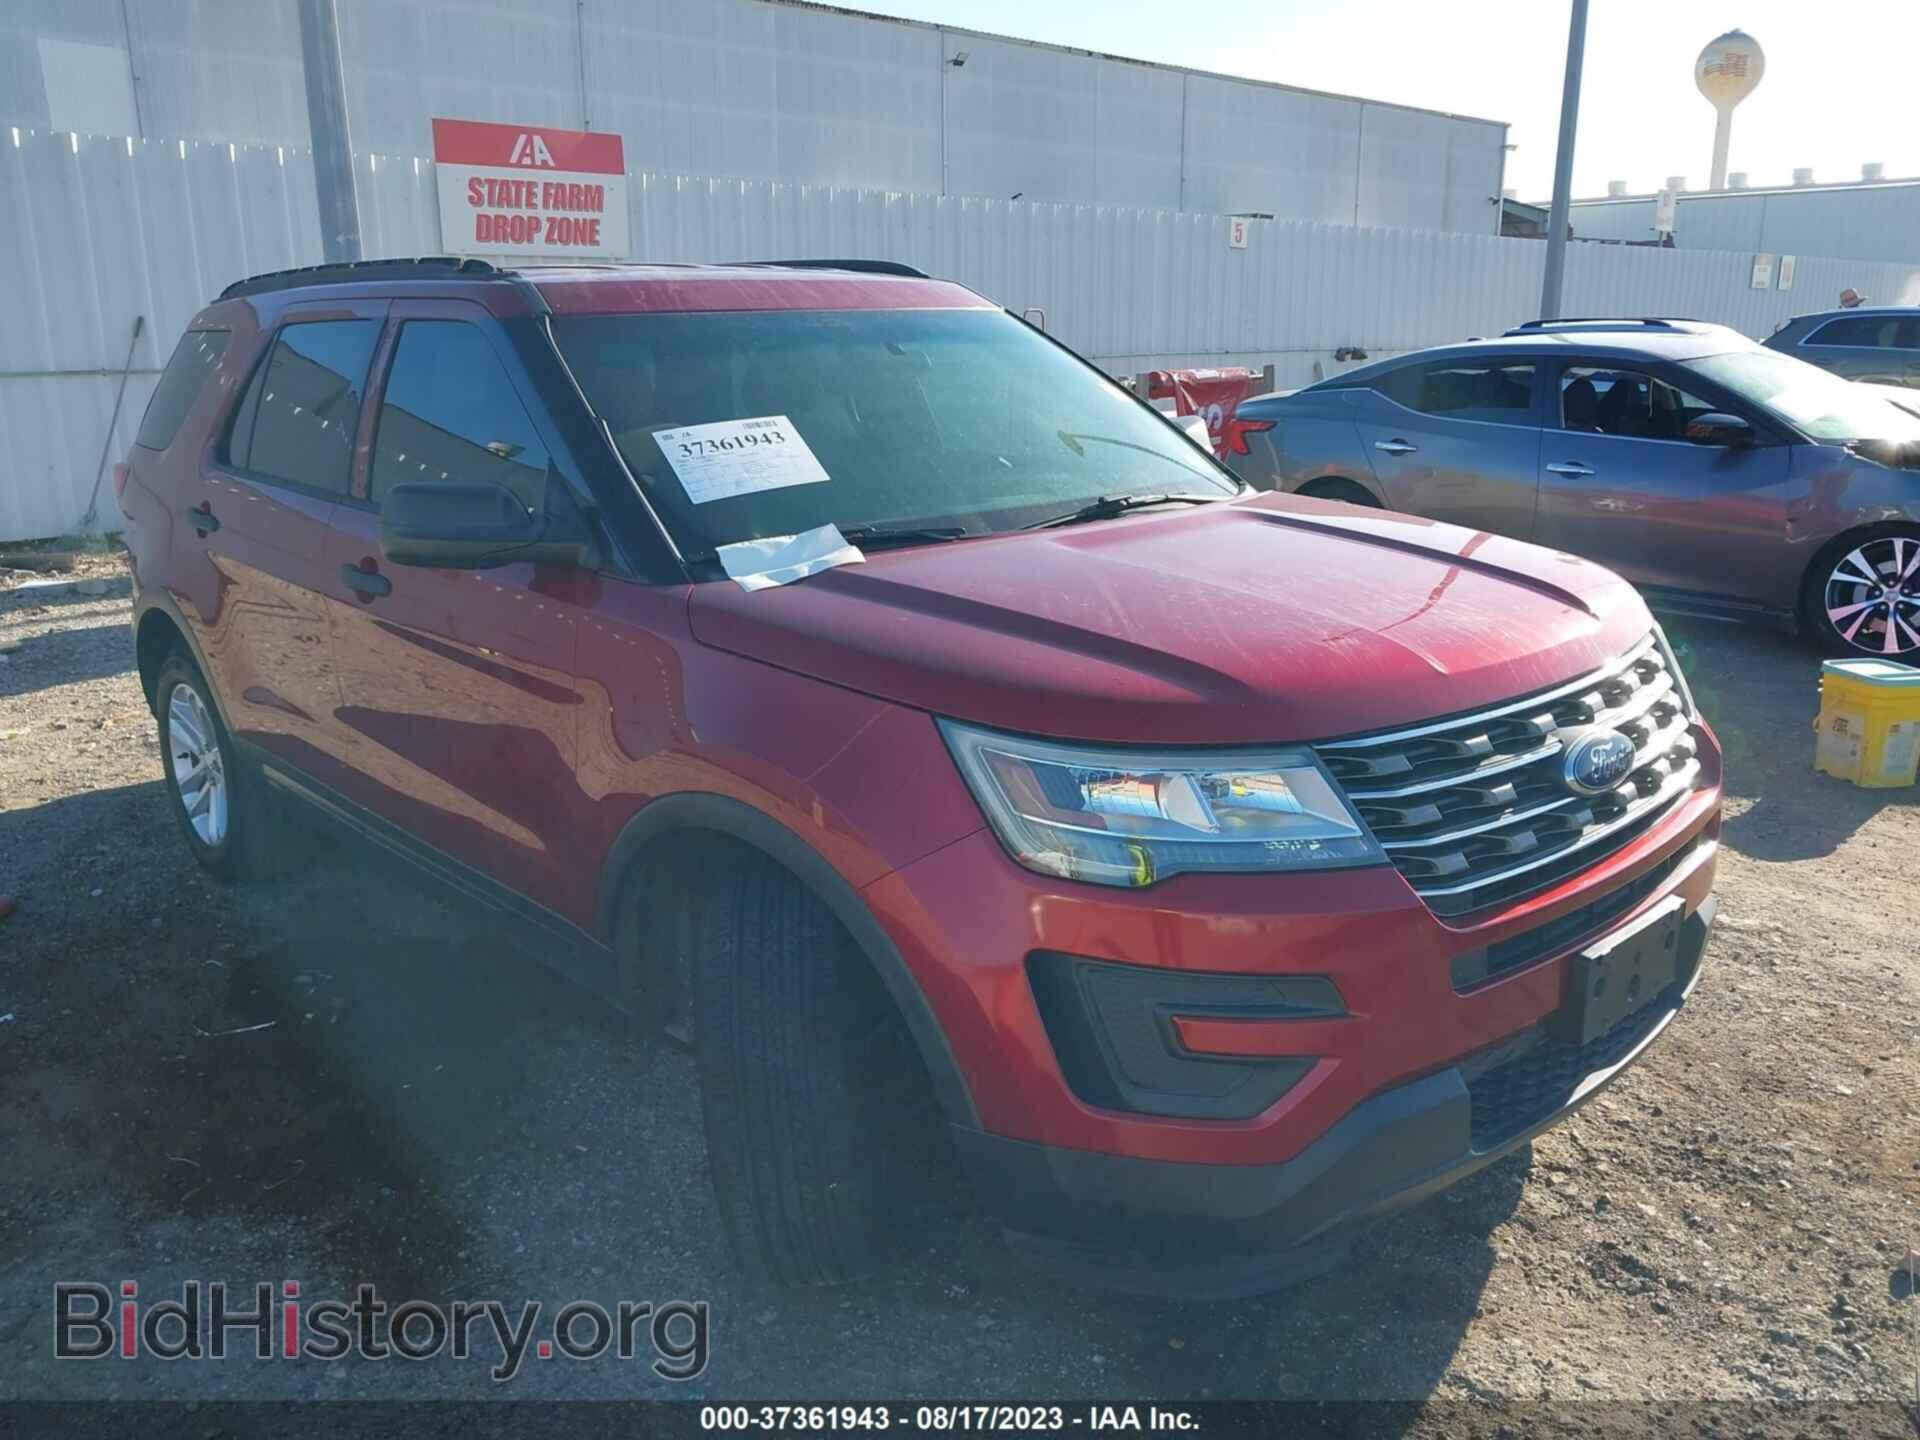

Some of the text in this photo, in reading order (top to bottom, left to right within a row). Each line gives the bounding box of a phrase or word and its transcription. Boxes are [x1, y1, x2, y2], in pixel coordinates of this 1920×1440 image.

[467, 177, 604, 213] STATE FARM
[475, 213, 601, 246] DROP ZONE
[1235, 223, 1243, 243] 5
[678, 431, 785, 458] 37361943
[1590, 741, 1632, 779] Ford
